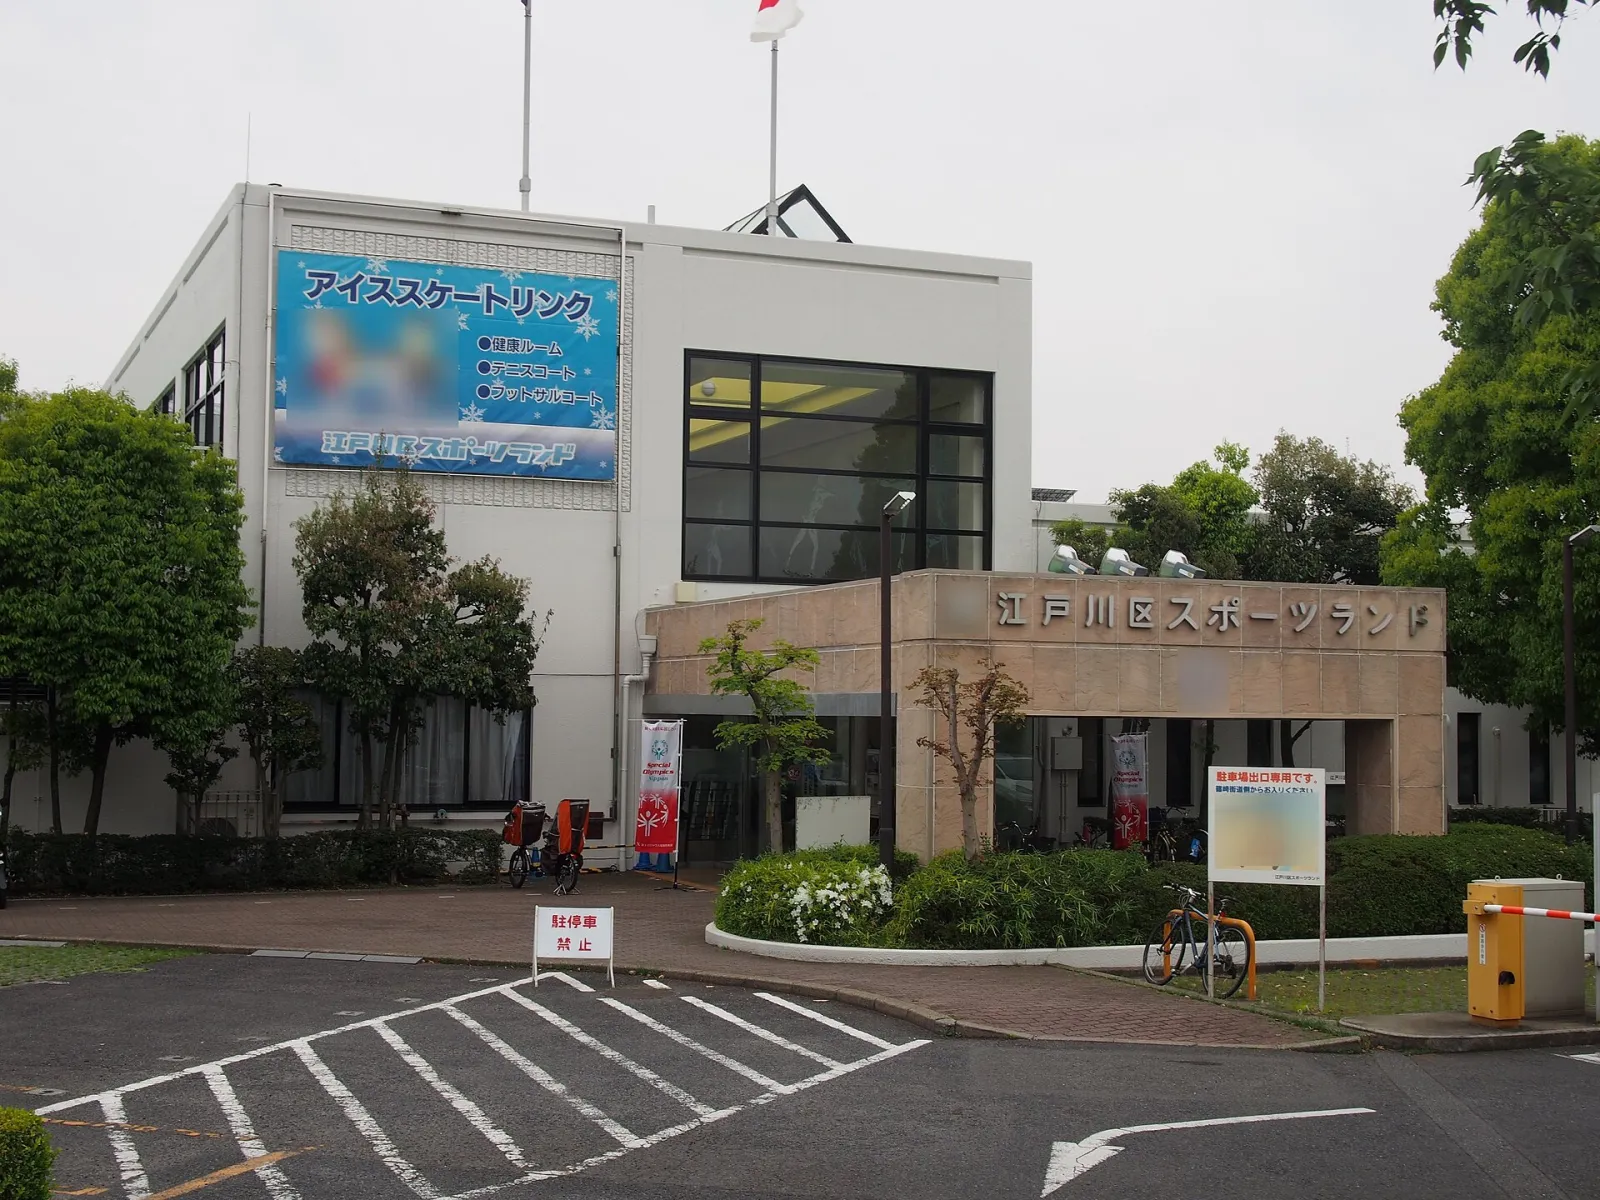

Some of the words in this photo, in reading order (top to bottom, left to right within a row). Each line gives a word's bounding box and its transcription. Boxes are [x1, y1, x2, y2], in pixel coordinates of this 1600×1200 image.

[303, 269, 593, 322] アイススケートリンク
[491, 336, 562, 356] 健康ルーム
[491, 361, 576, 381] テニスコート
[491, 385, 604, 406] フットサルコート
[321, 430, 577, 467] 江戸川区スポーツランド
[997, 591, 1429, 637] 江戸川区スポーツランド
[1216, 771, 1318, 784] 駐車場出口専用です。
[551, 914, 597, 929] 駐停車
[557, 937, 592, 951] 禁止
